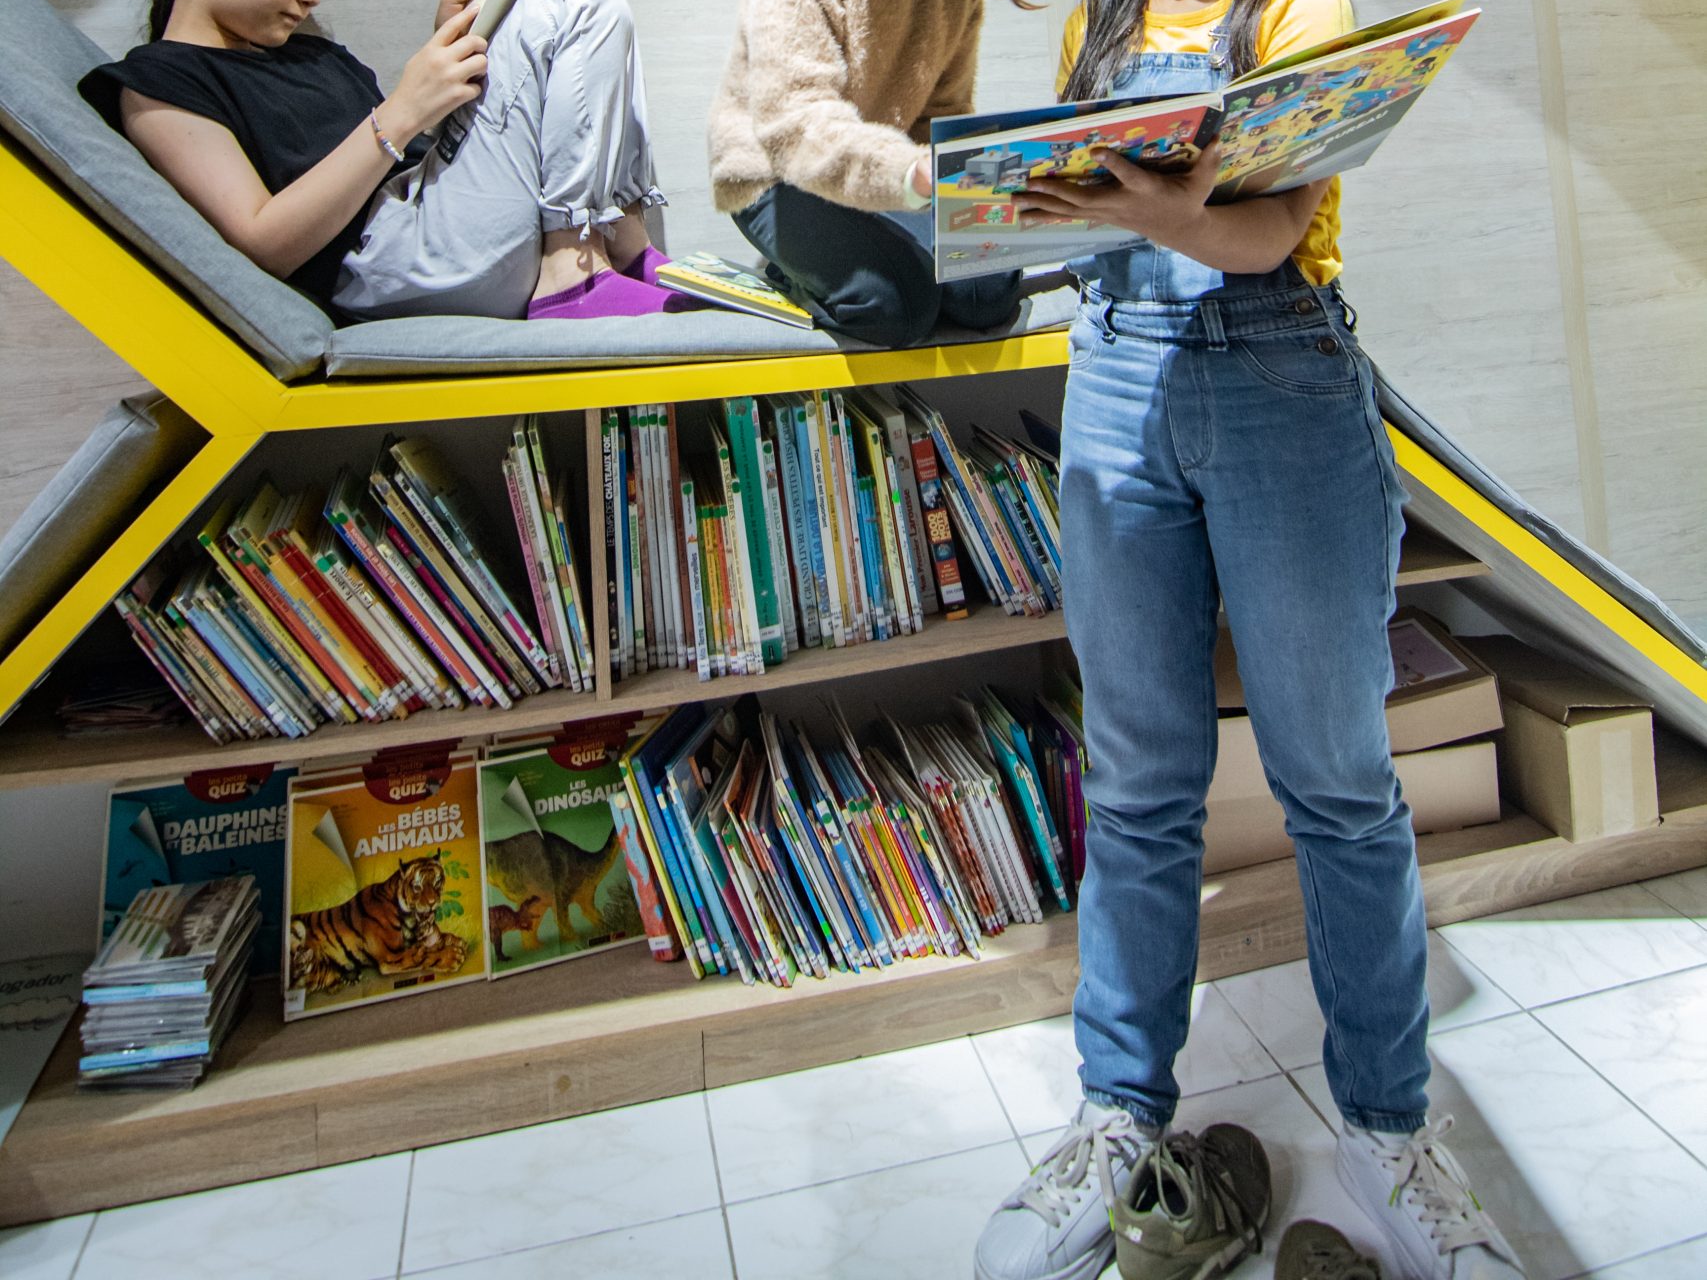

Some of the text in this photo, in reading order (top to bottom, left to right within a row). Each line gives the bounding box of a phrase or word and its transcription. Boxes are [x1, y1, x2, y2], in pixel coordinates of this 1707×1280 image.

[781, 421, 794, 463] HISTOIR
[602, 433, 615, 546] LE TEMPS DES CHÂTEAUX FOR
[787, 465, 800, 507] PETITES
[815, 464, 821, 472] ce
[818, 495, 827, 528] important
[793, 509, 803, 528] DES
[899, 488, 917, 537] Larousse
[927, 513, 940, 543] 1000
[630, 514, 639, 568] DINOSAURES
[796, 532, 808, 560] LIVRE
[327, 569, 354, 601] le sport
[800, 562, 813, 599] GRAND
[570, 748, 606, 767] QUIZ
[208, 780, 247, 799] QUIZ
[389, 781, 427, 801] QUIZ
[534, 781, 626, 816] DINOSAU
[569, 779, 587, 791] LES
[163, 804, 289, 841] DAUPHINS
[378, 801, 461, 834] LES BÉBÉS
[181, 823, 287, 856] BALEINES
[353, 819, 465, 858] ANIMAUX
[0, 972, 73, 995] ogador
